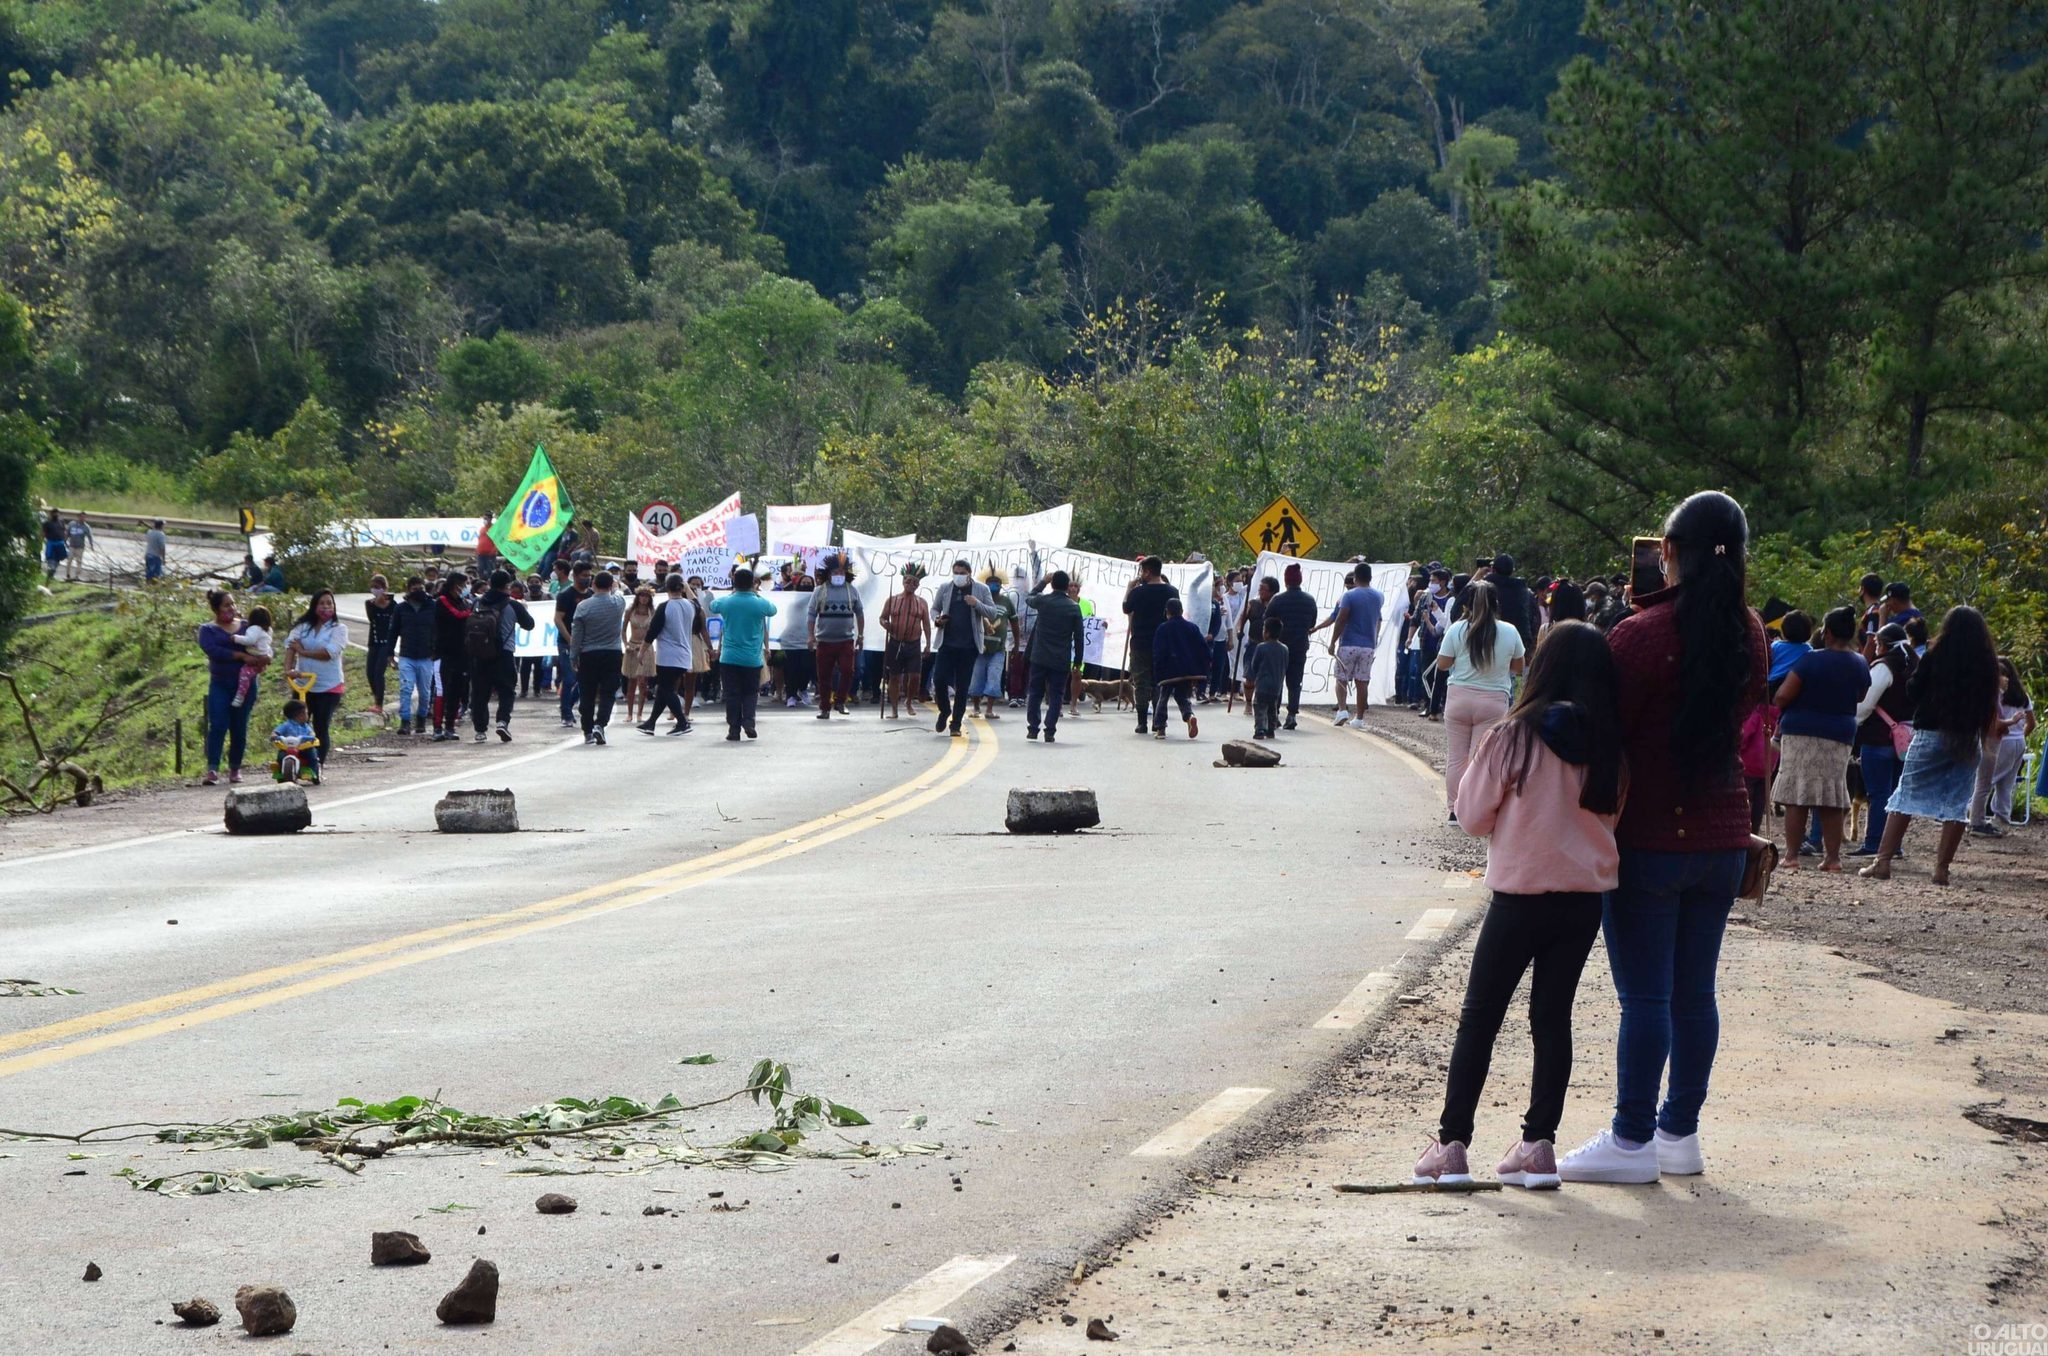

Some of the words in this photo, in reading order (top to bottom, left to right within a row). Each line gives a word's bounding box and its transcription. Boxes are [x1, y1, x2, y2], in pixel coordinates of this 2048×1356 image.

[647, 512, 673, 533] 40
[687, 555, 720, 566] TAMOS
[870, 550, 902, 577] OS
[686, 565, 719, 575] MARCO
